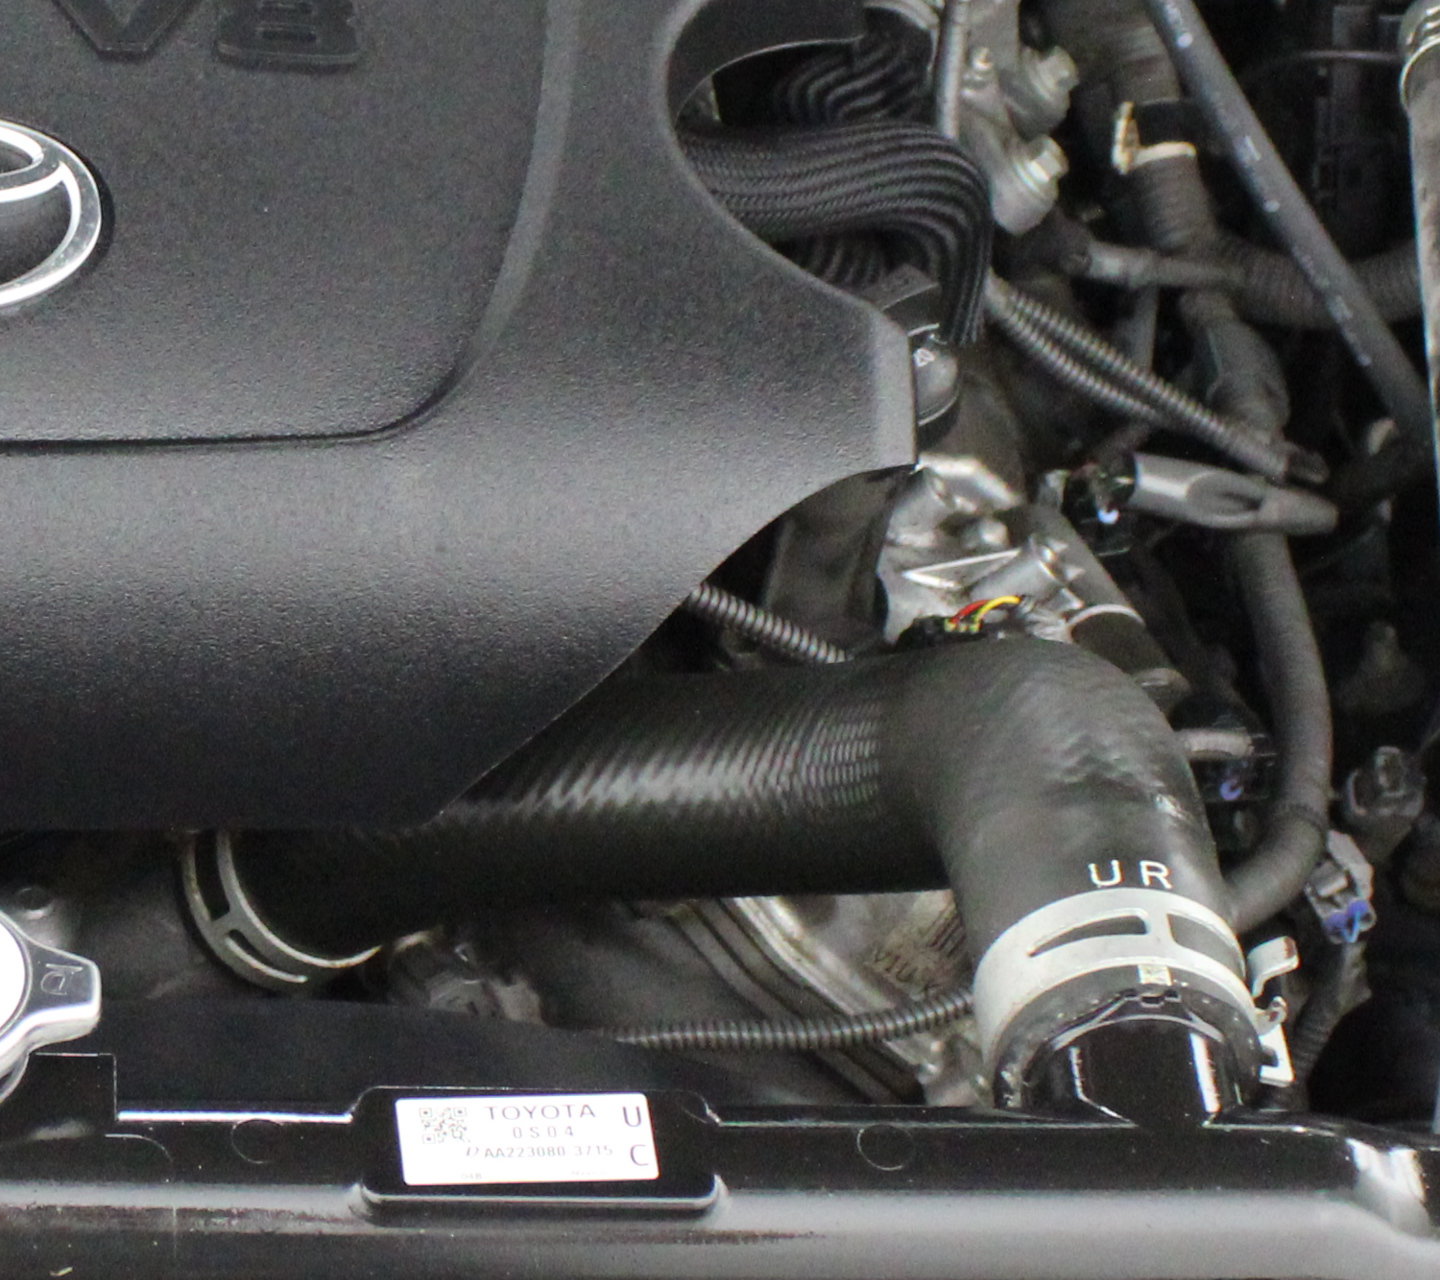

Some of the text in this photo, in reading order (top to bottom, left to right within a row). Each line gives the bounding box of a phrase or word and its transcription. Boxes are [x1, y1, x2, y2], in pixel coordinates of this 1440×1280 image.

[484, 1104, 596, 1122] TOYOTA
[622, 1105, 643, 1129] U
[628, 1143, 650, 1167] C
